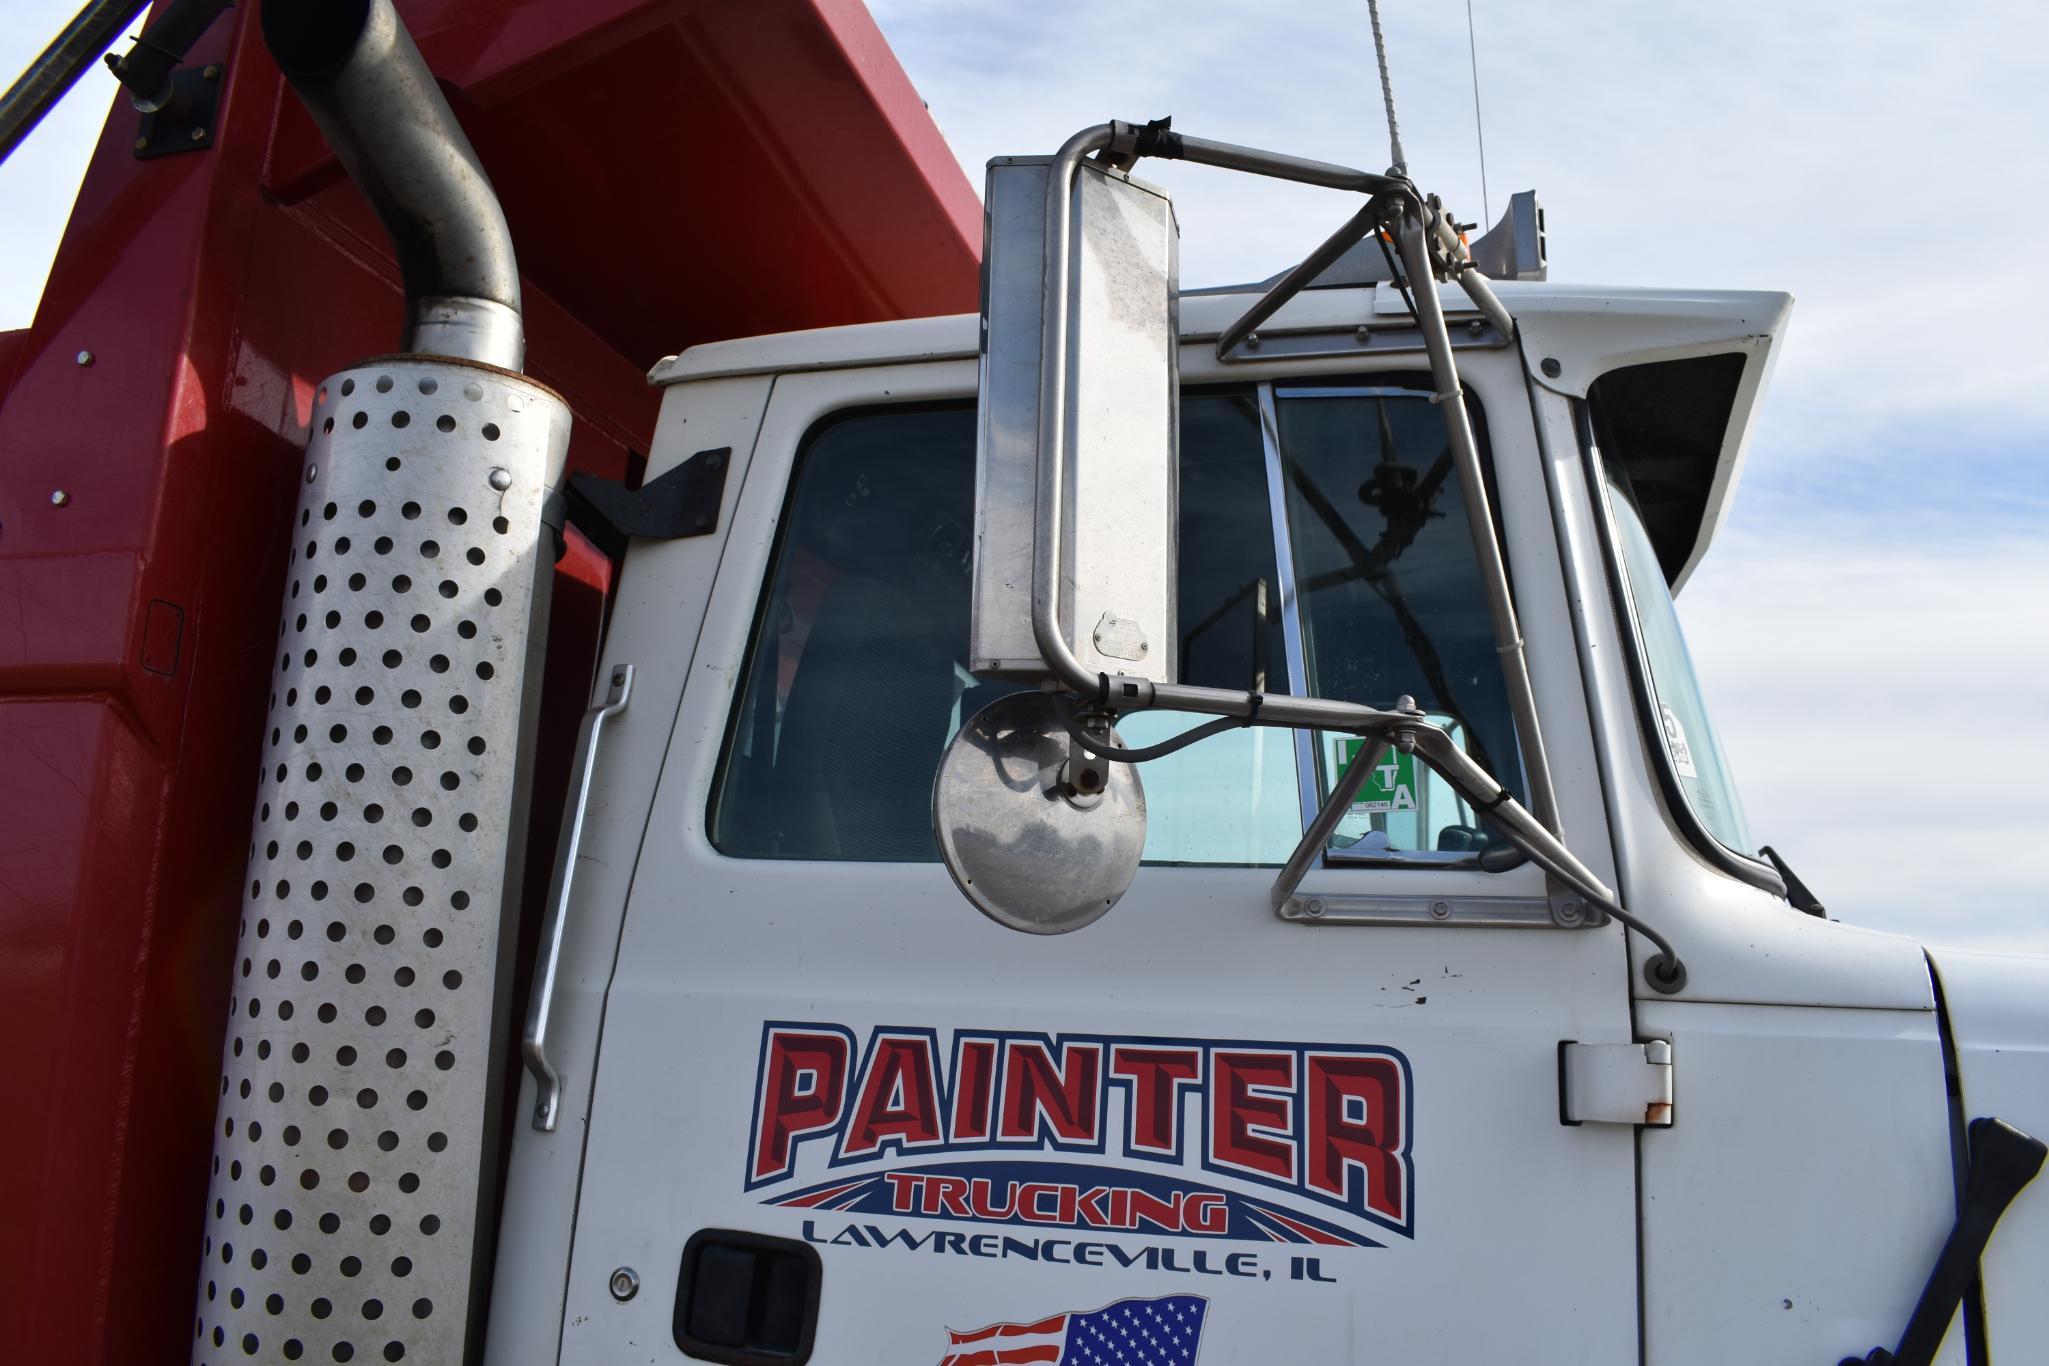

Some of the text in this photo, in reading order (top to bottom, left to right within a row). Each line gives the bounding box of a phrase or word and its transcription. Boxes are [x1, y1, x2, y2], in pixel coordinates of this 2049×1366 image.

[744, 1020, 1415, 1240] PAINTER
[884, 1172, 1229, 1235] TRUCKING
[803, 1220, 1338, 1283] LAWRENCEVILLE, IL
